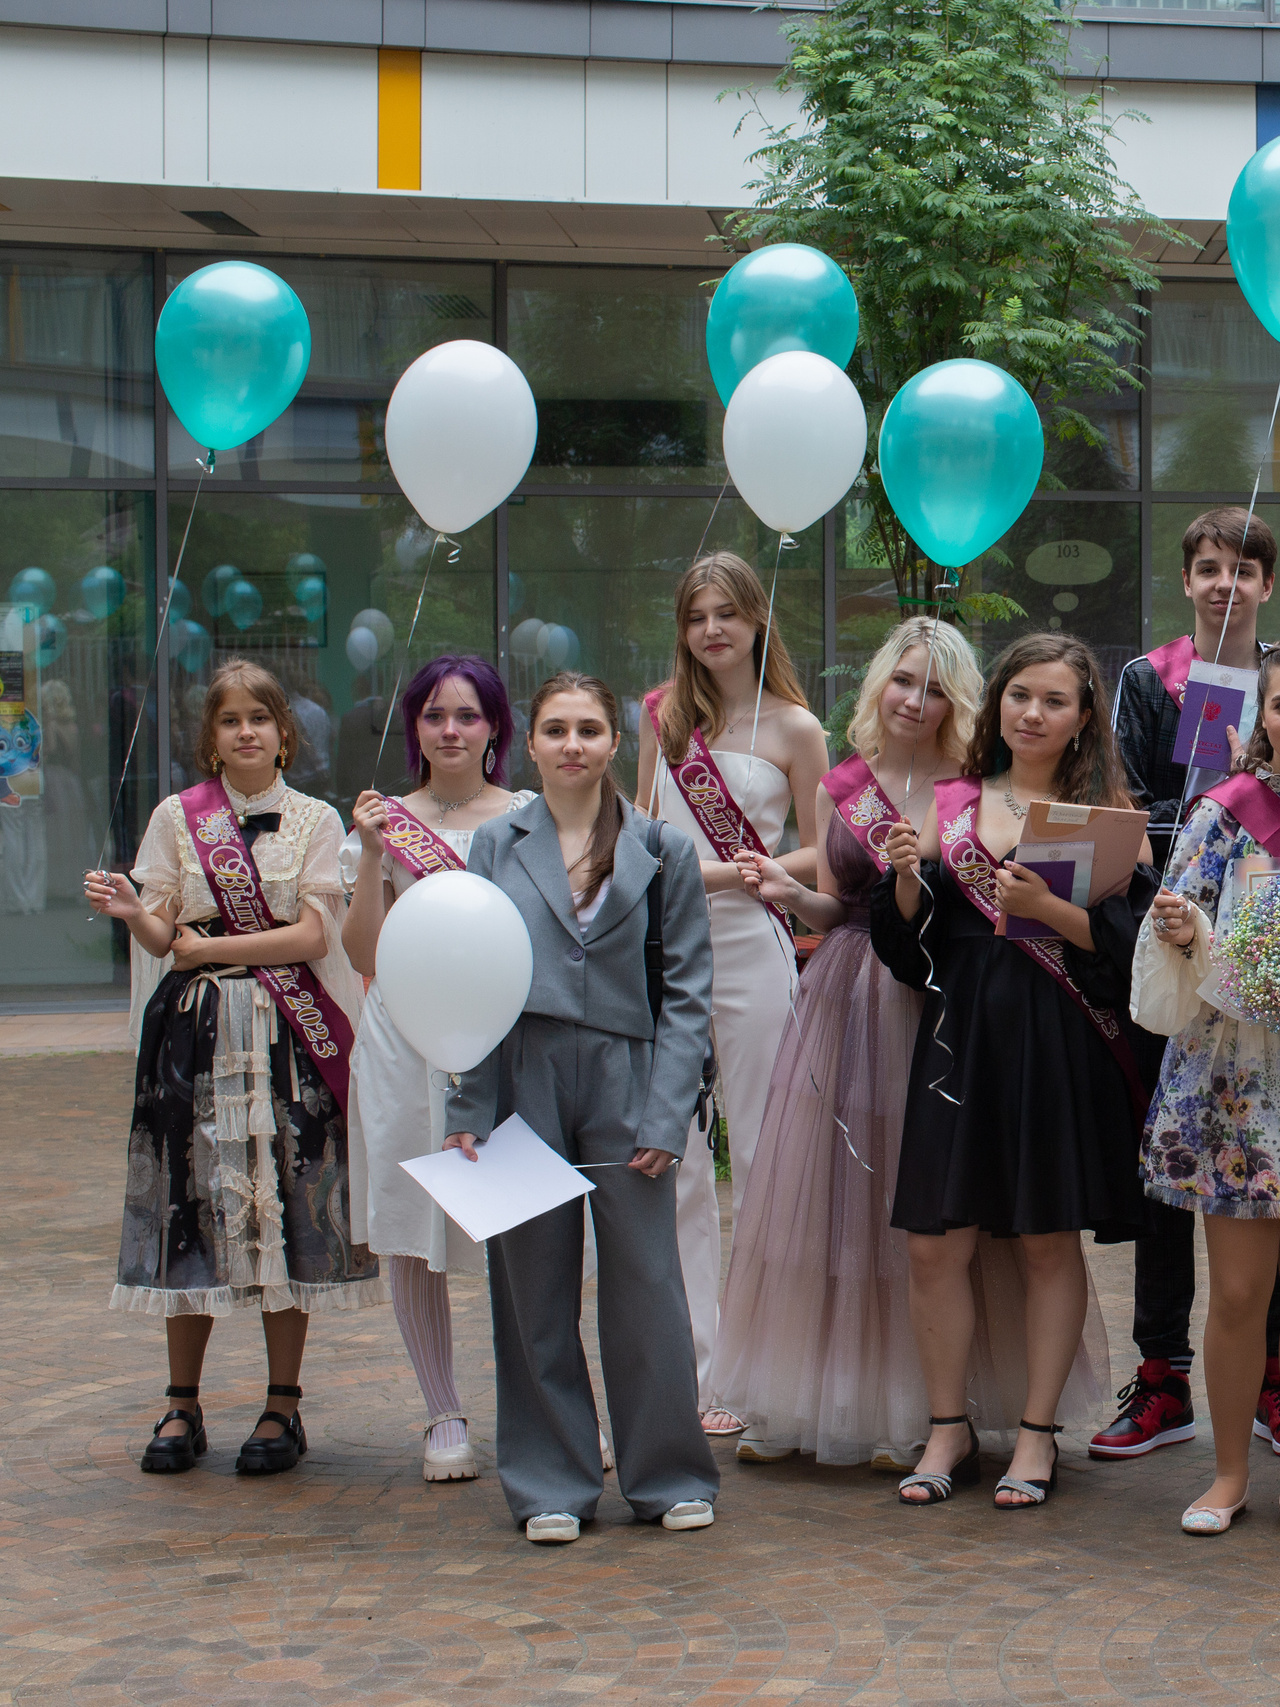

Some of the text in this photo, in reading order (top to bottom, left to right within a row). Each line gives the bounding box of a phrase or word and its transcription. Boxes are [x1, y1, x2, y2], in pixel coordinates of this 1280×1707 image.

[1056, 544, 1081, 559] 103
[1189, 739, 1223, 750] АТЕСТАТ
[678, 761, 749, 856] Выпус
[283, 990, 339, 1059] 2023
